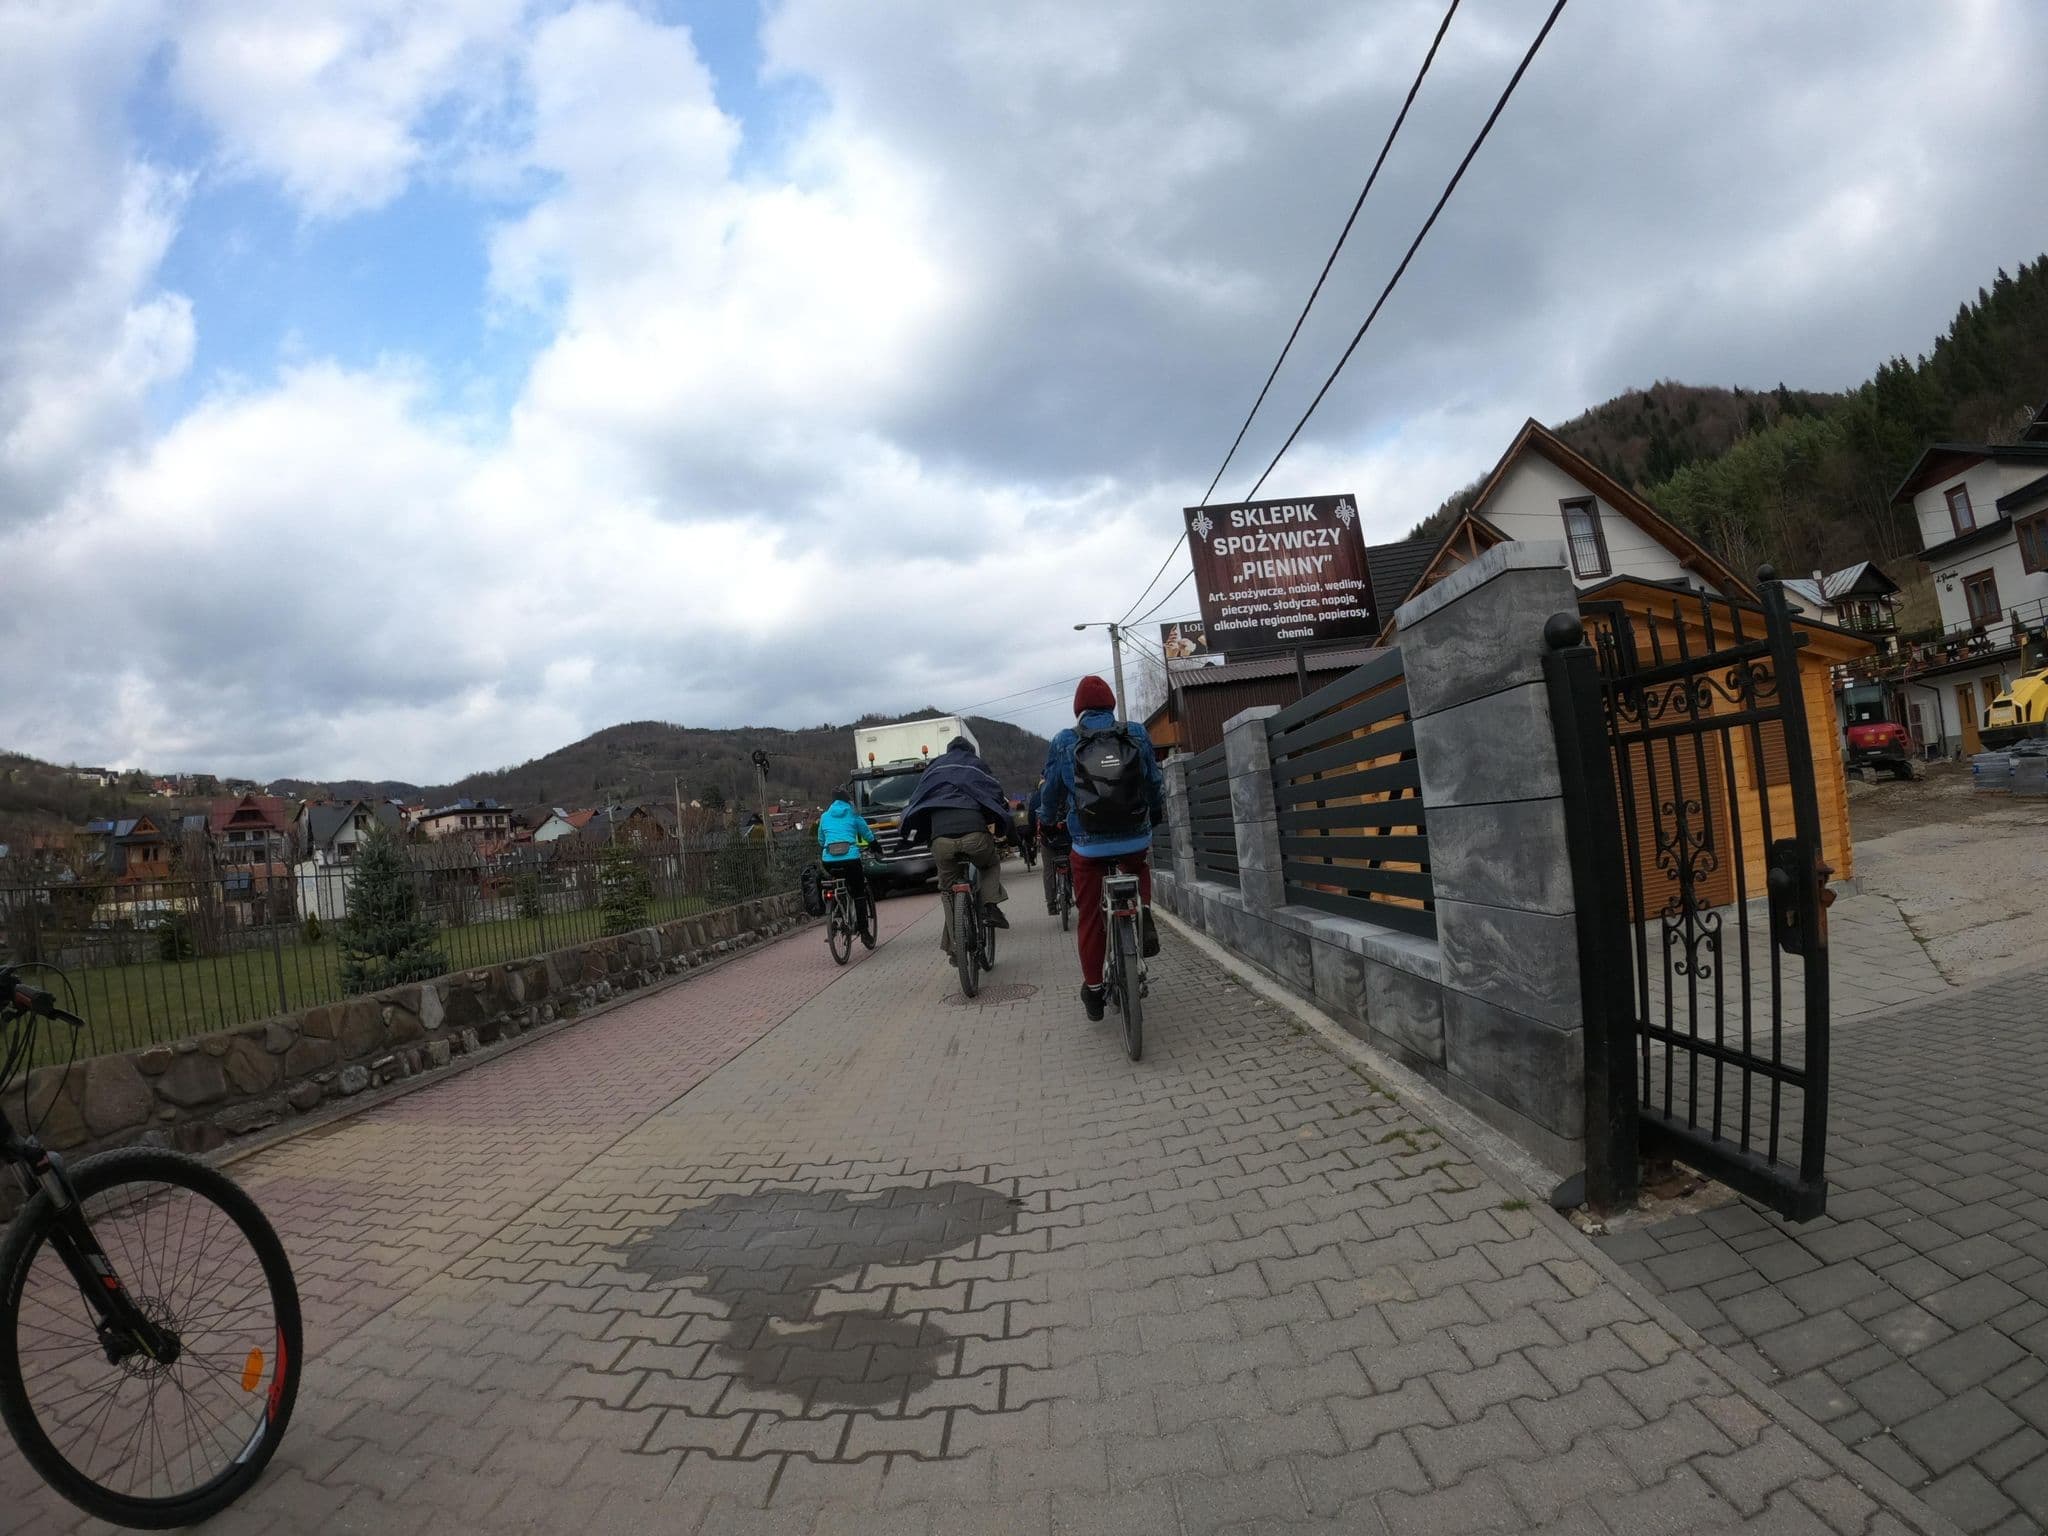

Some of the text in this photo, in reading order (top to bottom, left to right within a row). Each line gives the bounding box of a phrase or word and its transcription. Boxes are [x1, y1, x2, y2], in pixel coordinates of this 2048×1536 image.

[1230, 504, 1318, 528] SKLEPIK
[1213, 528, 1341, 556] SPOŻYWCZY
[1208, 578, 1366, 602] Art. spożywcze, nabiał, wędliny,
[1221, 593, 1358, 617] pieczywo, słodycze, napoje,
[1214, 608, 1370, 631] alkohole regionalne, papierosy,
[1277, 627, 1314, 640] chemia
